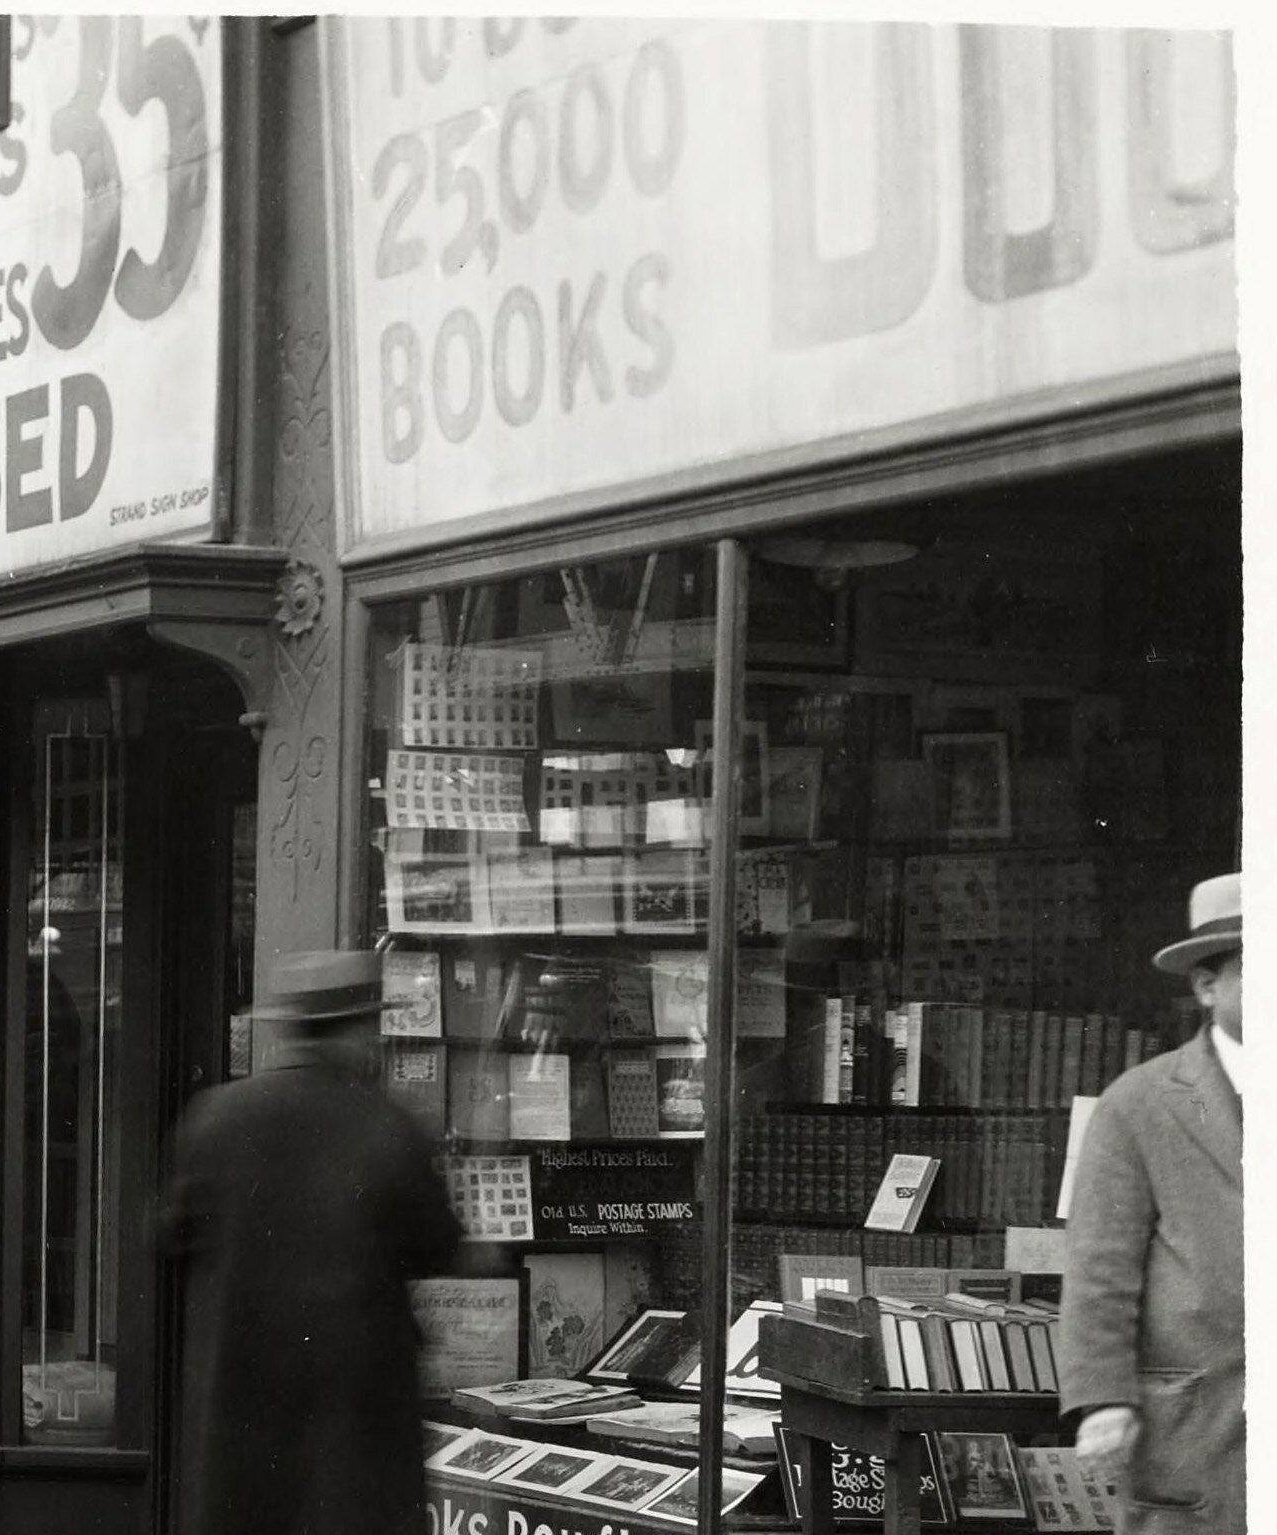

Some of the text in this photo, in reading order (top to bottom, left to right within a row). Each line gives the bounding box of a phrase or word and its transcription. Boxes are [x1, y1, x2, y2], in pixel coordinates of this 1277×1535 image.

[370, 37, 687, 279] 25,000
[380, 252, 675, 465] BOOKS
[110, 487, 209, 527] STRAND SIGN SHOP
[568, 1223, 608, 1236] Inquire
[597, 1204, 645, 1220] POSTAGE
[647, 1203, 693, 1219] STAMPS
